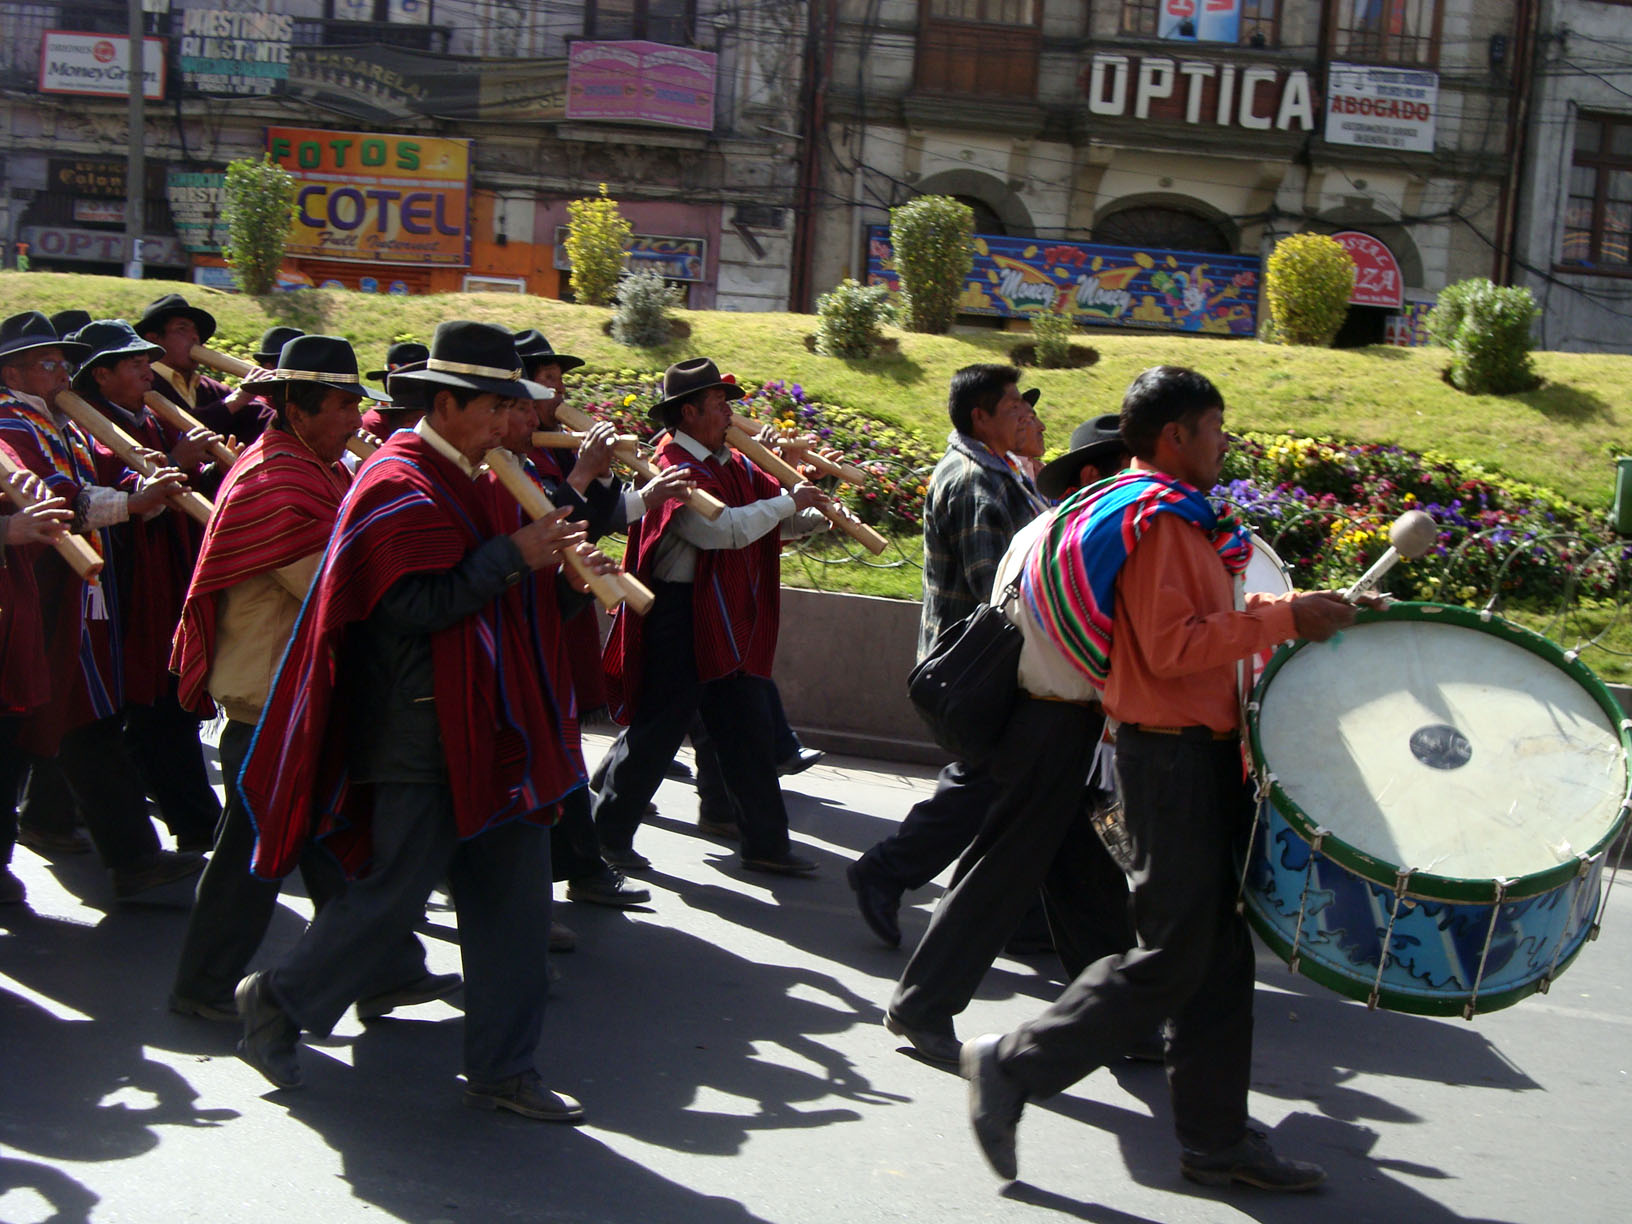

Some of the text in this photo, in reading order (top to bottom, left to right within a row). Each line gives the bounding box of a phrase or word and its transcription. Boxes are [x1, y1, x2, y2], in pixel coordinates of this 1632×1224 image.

[47, 61, 157, 82] MoneyGrm
[1088, 54, 1315, 131] OPTICA
[1331, 94, 1430, 123] ABOGADO
[272, 136, 422, 171] FOTOS
[298, 184, 461, 236] COTEL
